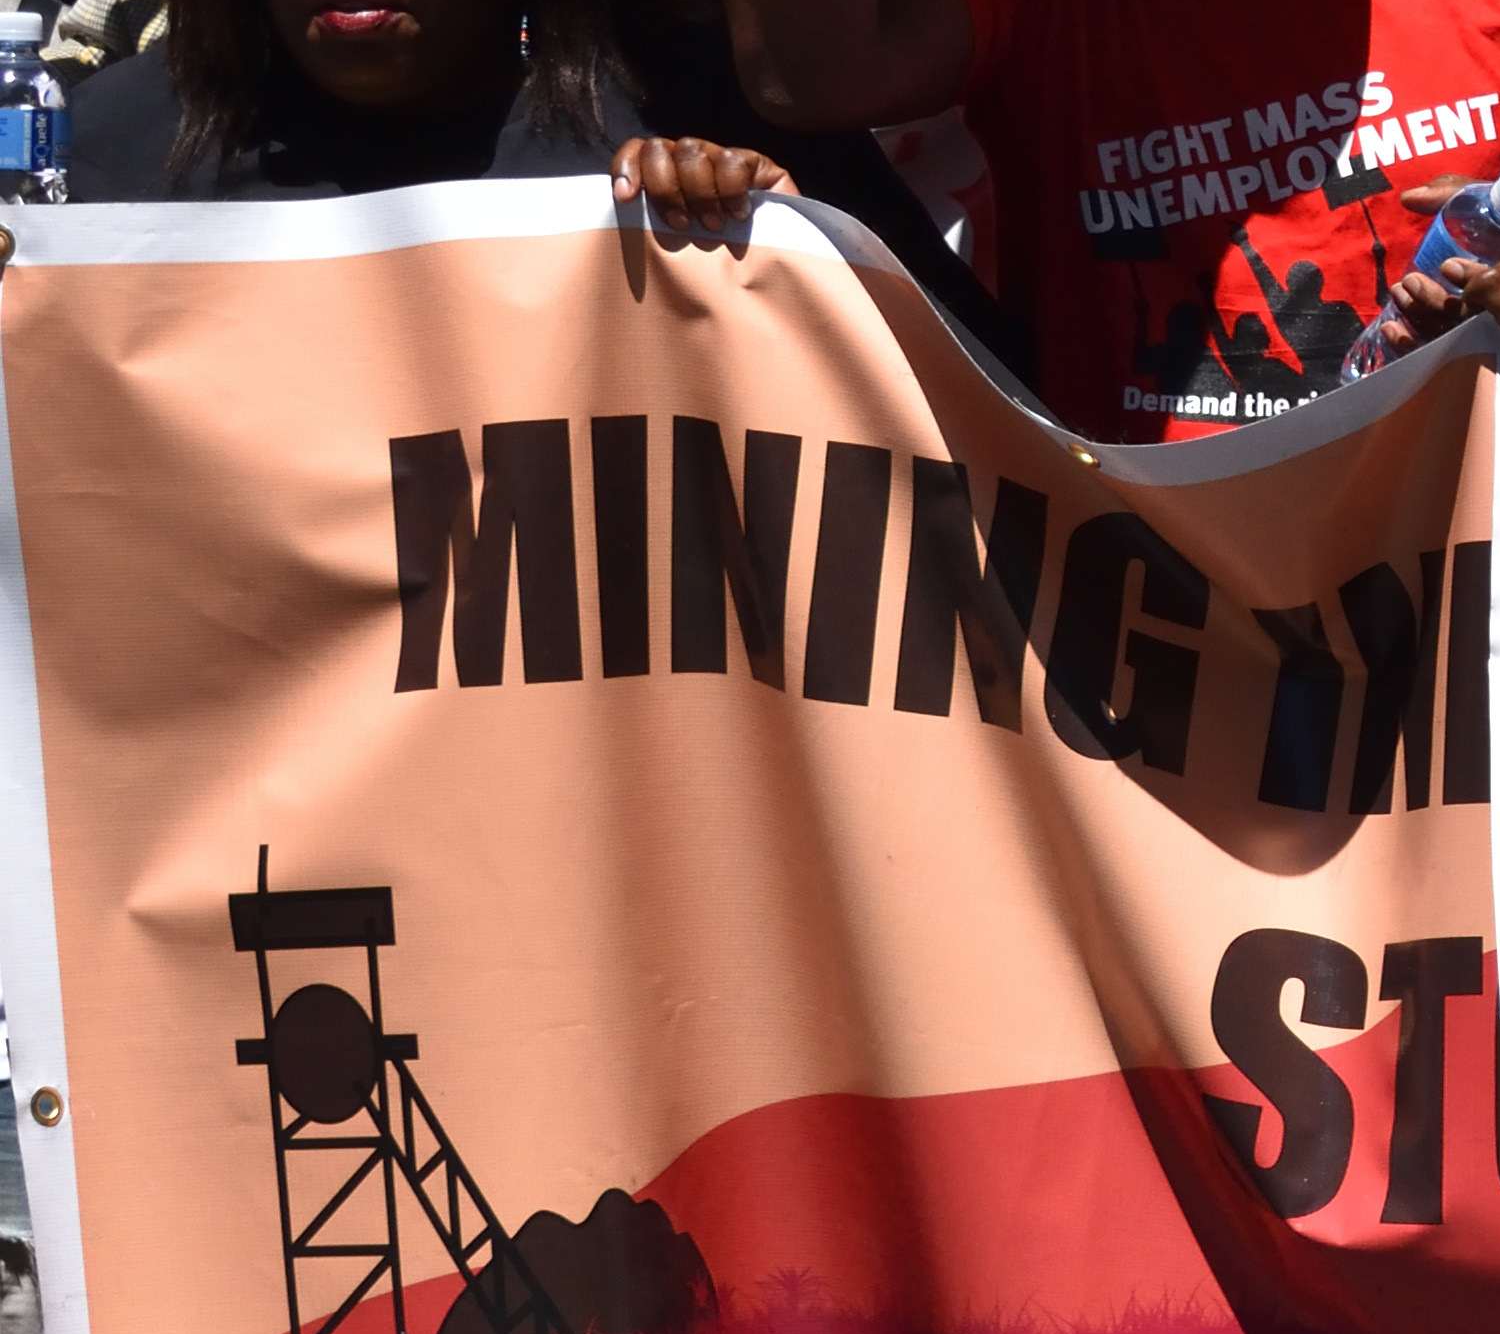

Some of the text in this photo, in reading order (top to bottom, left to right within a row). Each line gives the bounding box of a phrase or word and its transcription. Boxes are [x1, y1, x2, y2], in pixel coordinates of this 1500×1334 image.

[1078, 93, 1500, 235] UNEMPLOYMENT
[1098, 70, 1394, 184] FIGHT MASS
[1123, 384, 1238, 417] Demand
[1244, 391, 1290, 418] the
[388, 412, 1210, 777] MINING
